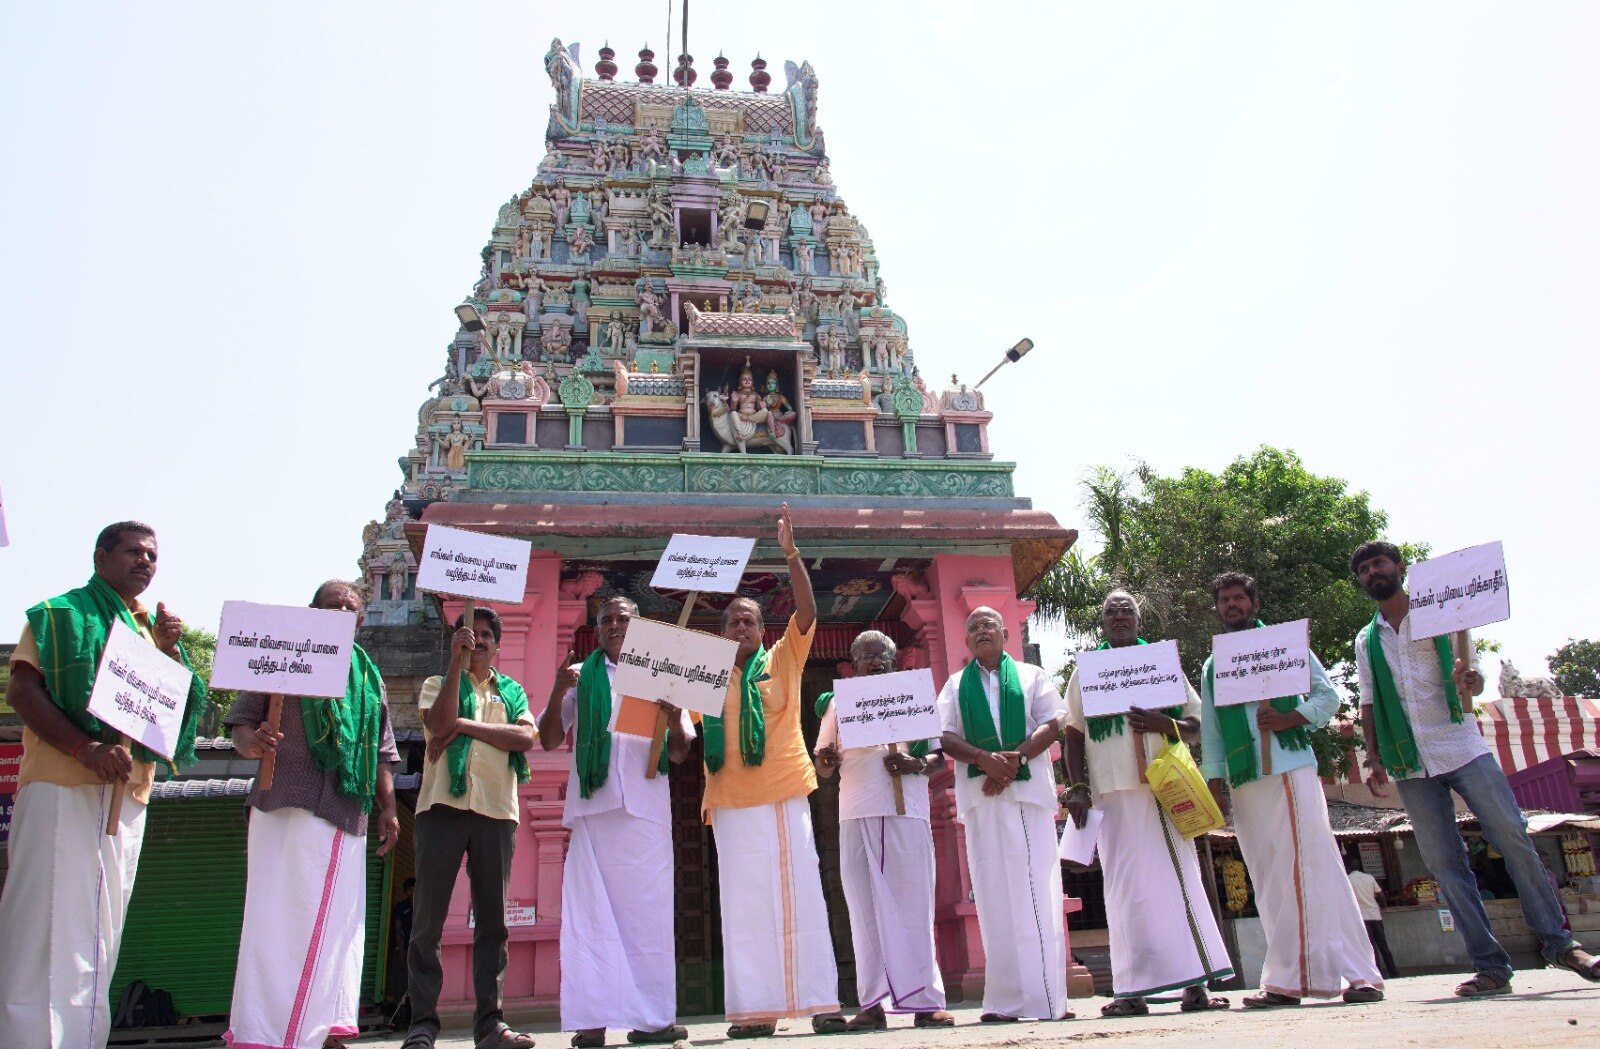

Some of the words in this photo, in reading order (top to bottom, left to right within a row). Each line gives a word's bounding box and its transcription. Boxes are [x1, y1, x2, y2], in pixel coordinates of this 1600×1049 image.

[430, 548, 454, 561] எங்கள்
[454, 552, 482, 566] விவசாய
[482, 557, 495, 571] பூமி
[495, 562, 517, 572] யானை
[445, 567, 477, 582] வழித்தடம்
[1410, 588, 1435, 609] எங்கள்
[1436, 585, 1464, 609] பூமியை
[228, 630, 258, 648] எங்கள்
[259, 634, 294, 651] விவசாய
[294, 638, 310, 657] பூமி
[311, 644, 339, 655] யானை
[248, 655, 288, 675] வழித்தடம்
[619, 648, 651, 668] எங்கள்
[651, 657, 684, 677] பூமியை
[108, 657, 128, 679] எங்கள்
[147, 686, 160, 703] பூமி
